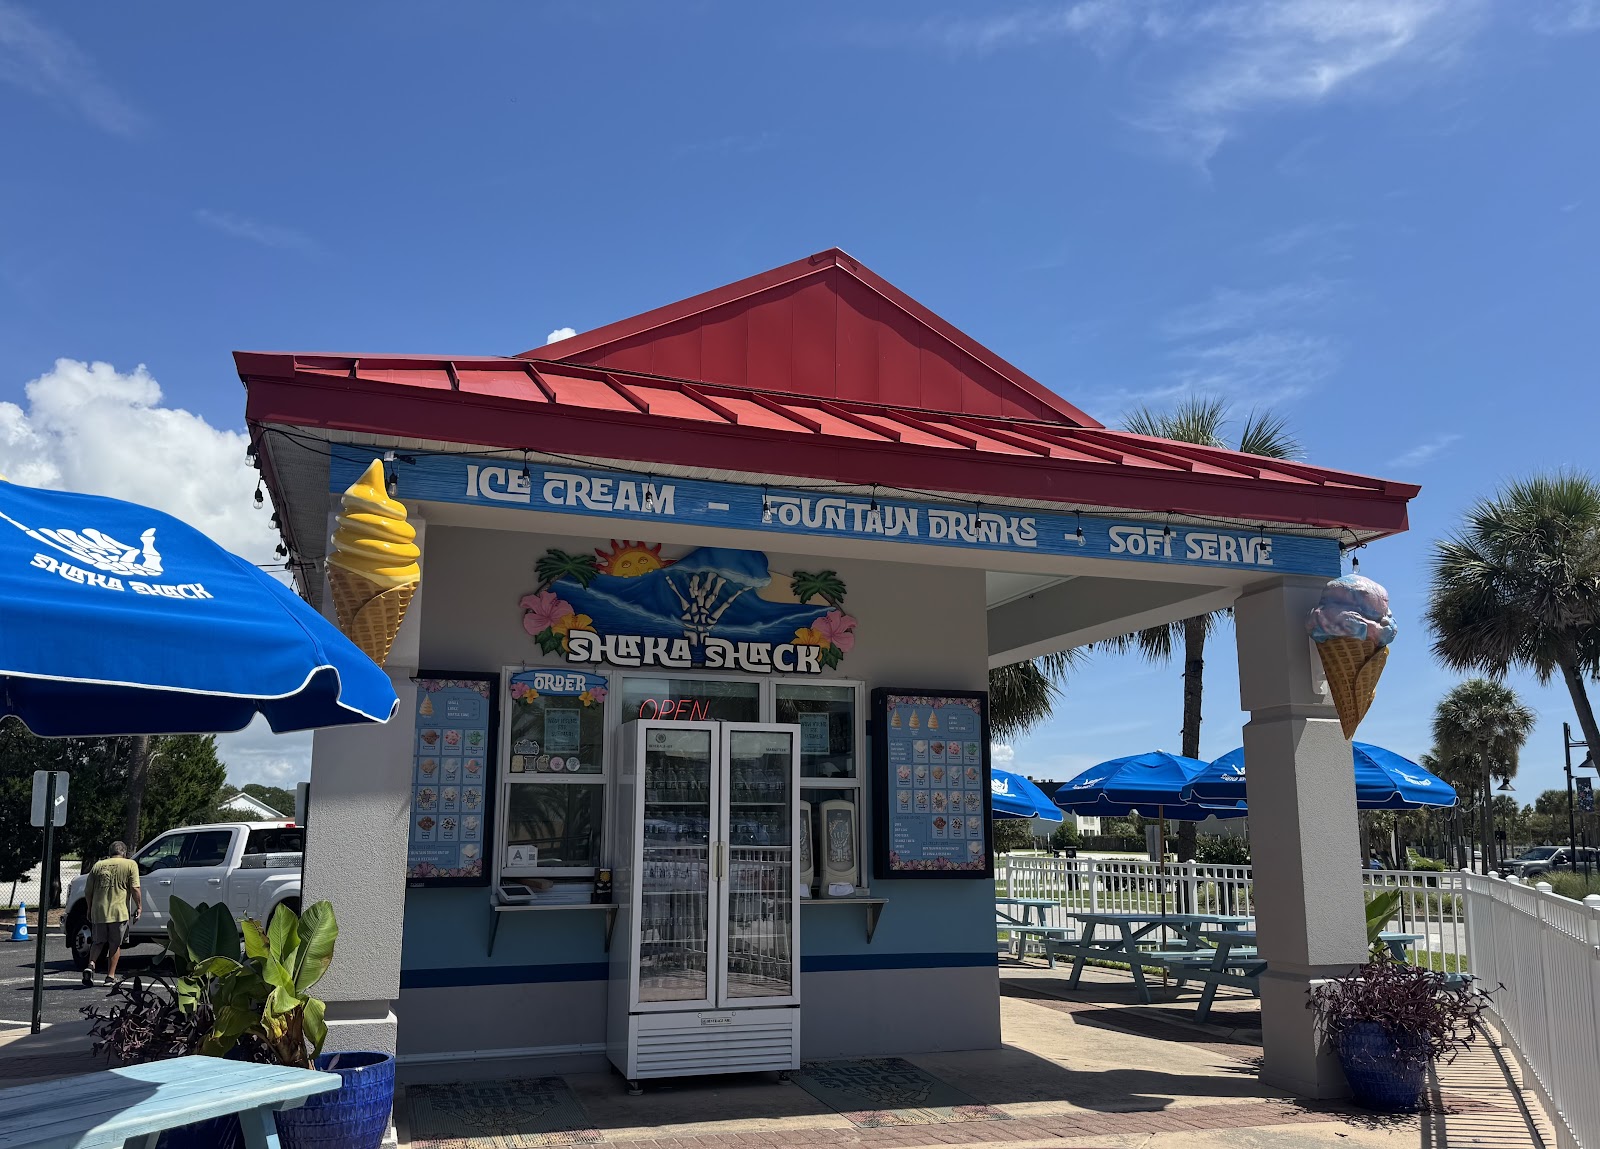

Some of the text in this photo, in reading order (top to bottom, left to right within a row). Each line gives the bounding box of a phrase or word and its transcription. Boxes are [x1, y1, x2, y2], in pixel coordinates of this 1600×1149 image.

[465, 464, 531, 504] ICE
[542, 471, 675, 516] CREAM
[761, 493, 919, 537] FOUNTAIN
[927, 508, 1038, 548] DRINKS
[1108, 525, 1176, 557] SOFT
[1184, 531, 1275, 566] SERVE
[30, 552, 214, 599] SHAKA SHACK
[568, 630, 822, 673] SHAKA SHACK
[533, 672, 587, 692] ORDER
[639, 698, 710, 721] OPEN
